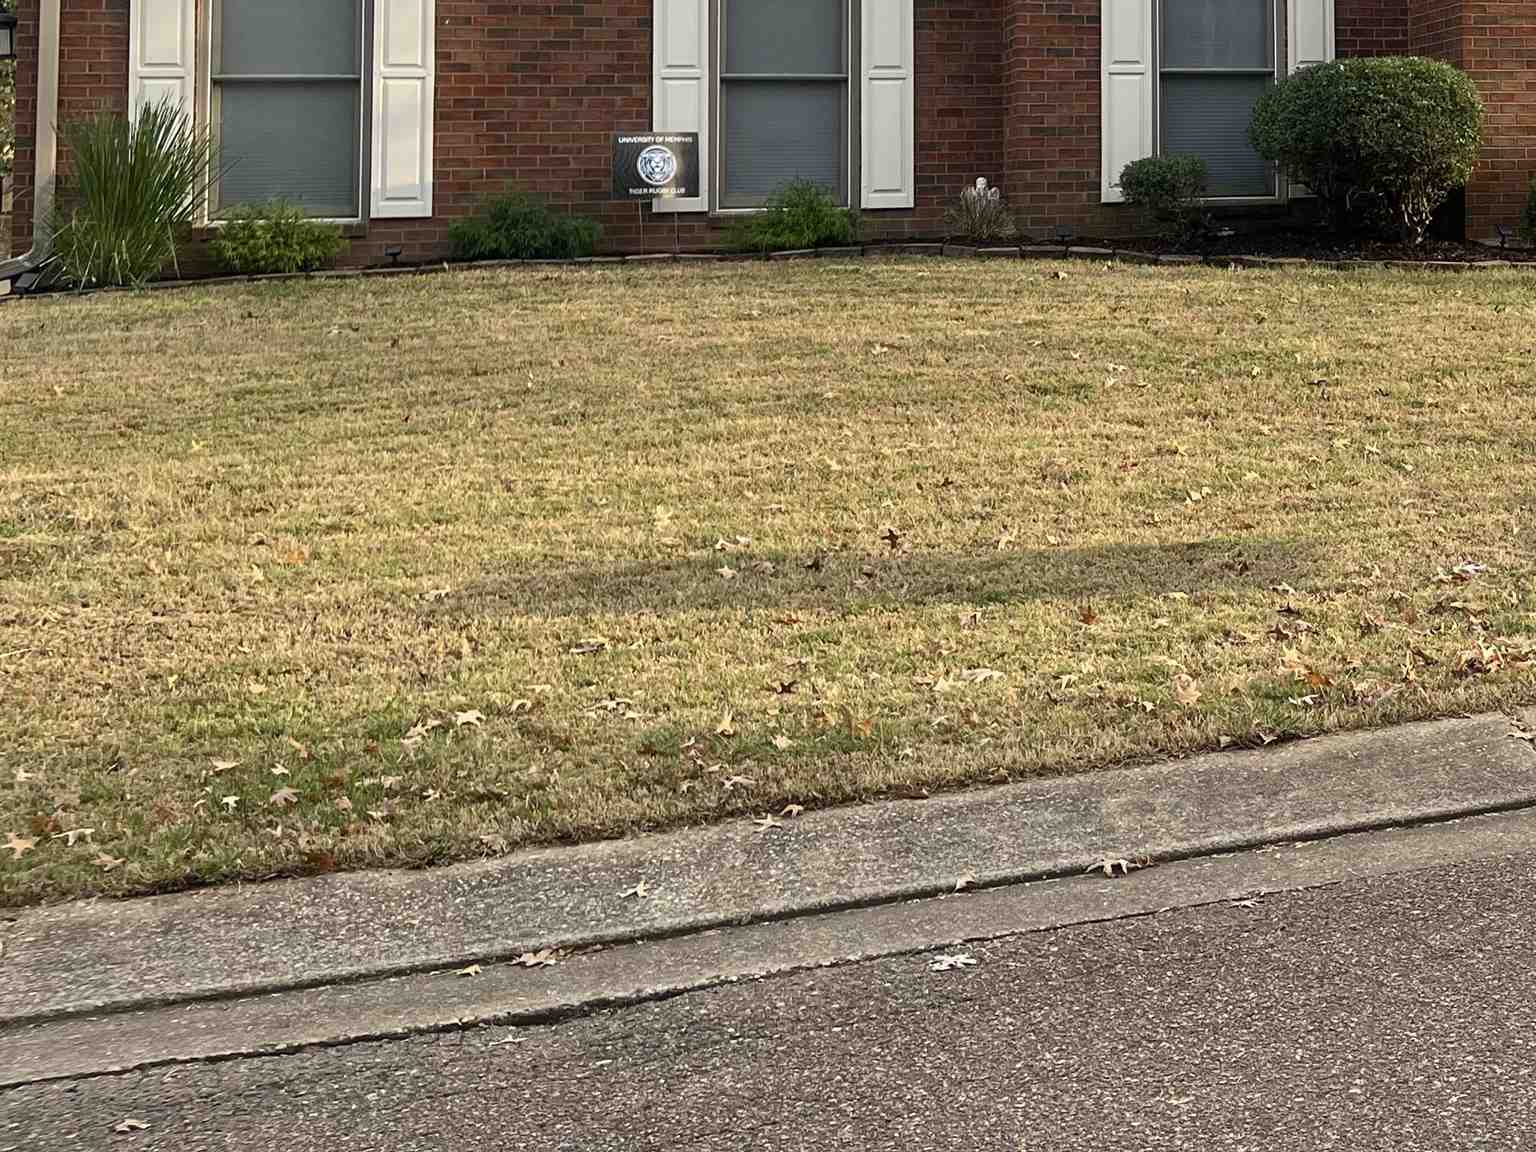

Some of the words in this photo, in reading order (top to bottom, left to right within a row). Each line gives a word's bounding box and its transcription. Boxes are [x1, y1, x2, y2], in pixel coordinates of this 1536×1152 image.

[618, 135, 655, 144] UNIVERSITY
[655, 135, 664, 144] OF
[664, 135, 693, 144] MEMPHIS
